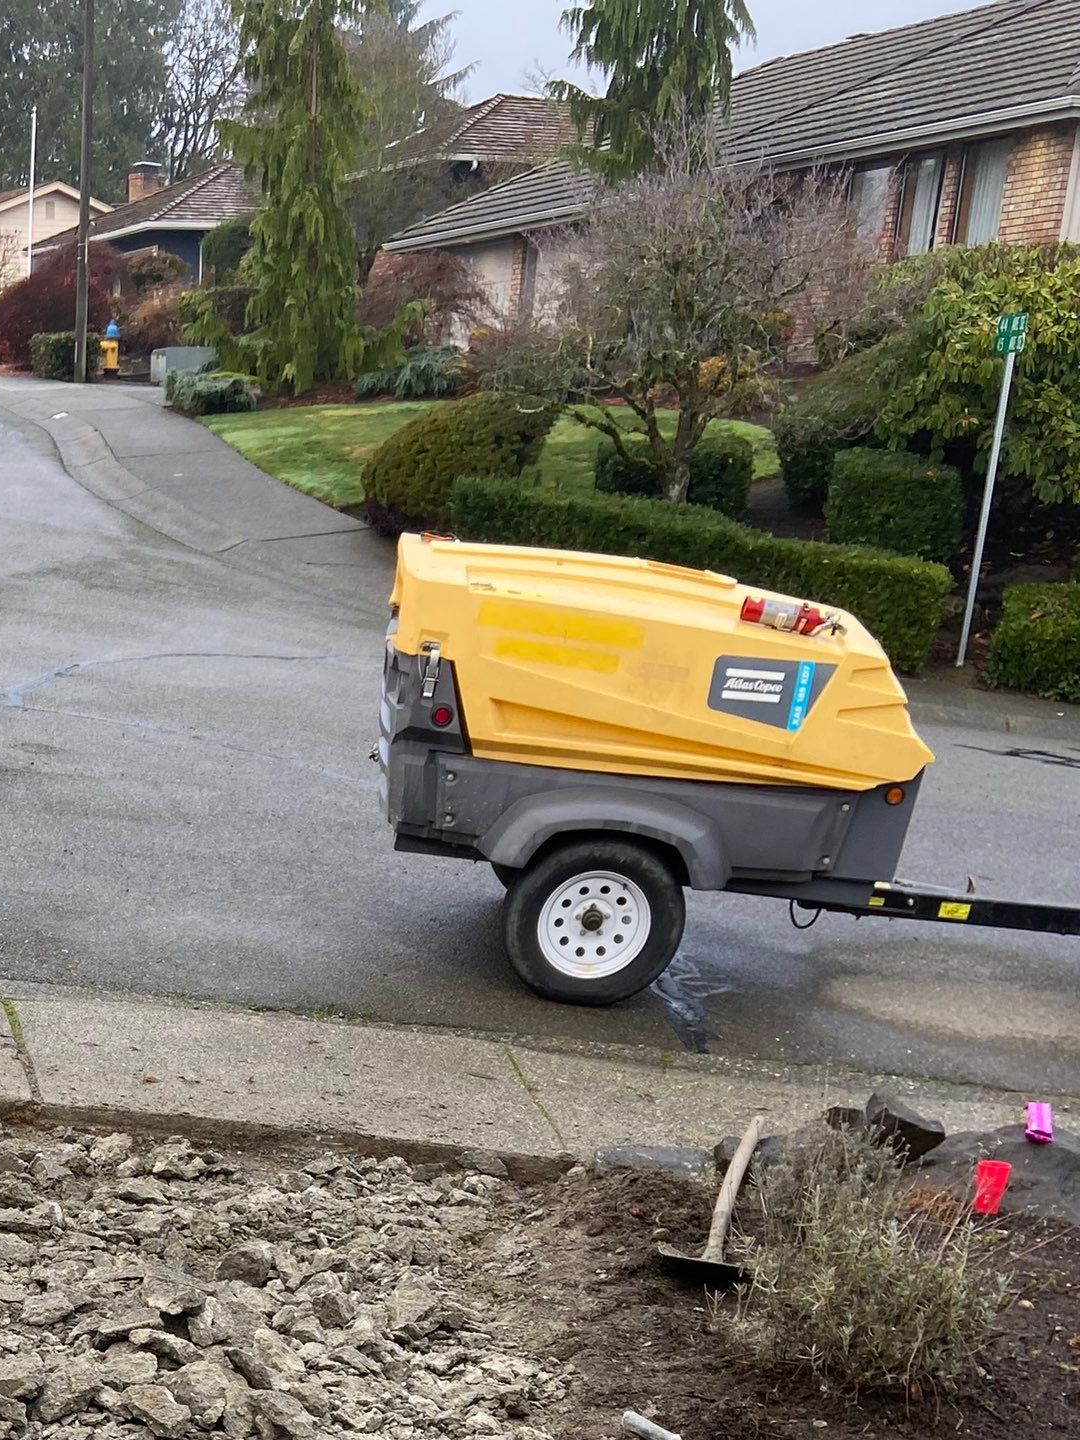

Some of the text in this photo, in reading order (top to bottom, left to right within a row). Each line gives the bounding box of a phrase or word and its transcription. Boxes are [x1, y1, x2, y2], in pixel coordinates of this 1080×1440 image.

[724, 678, 783, 693] Atlas Copco
[792, 706, 802, 726] XAS
